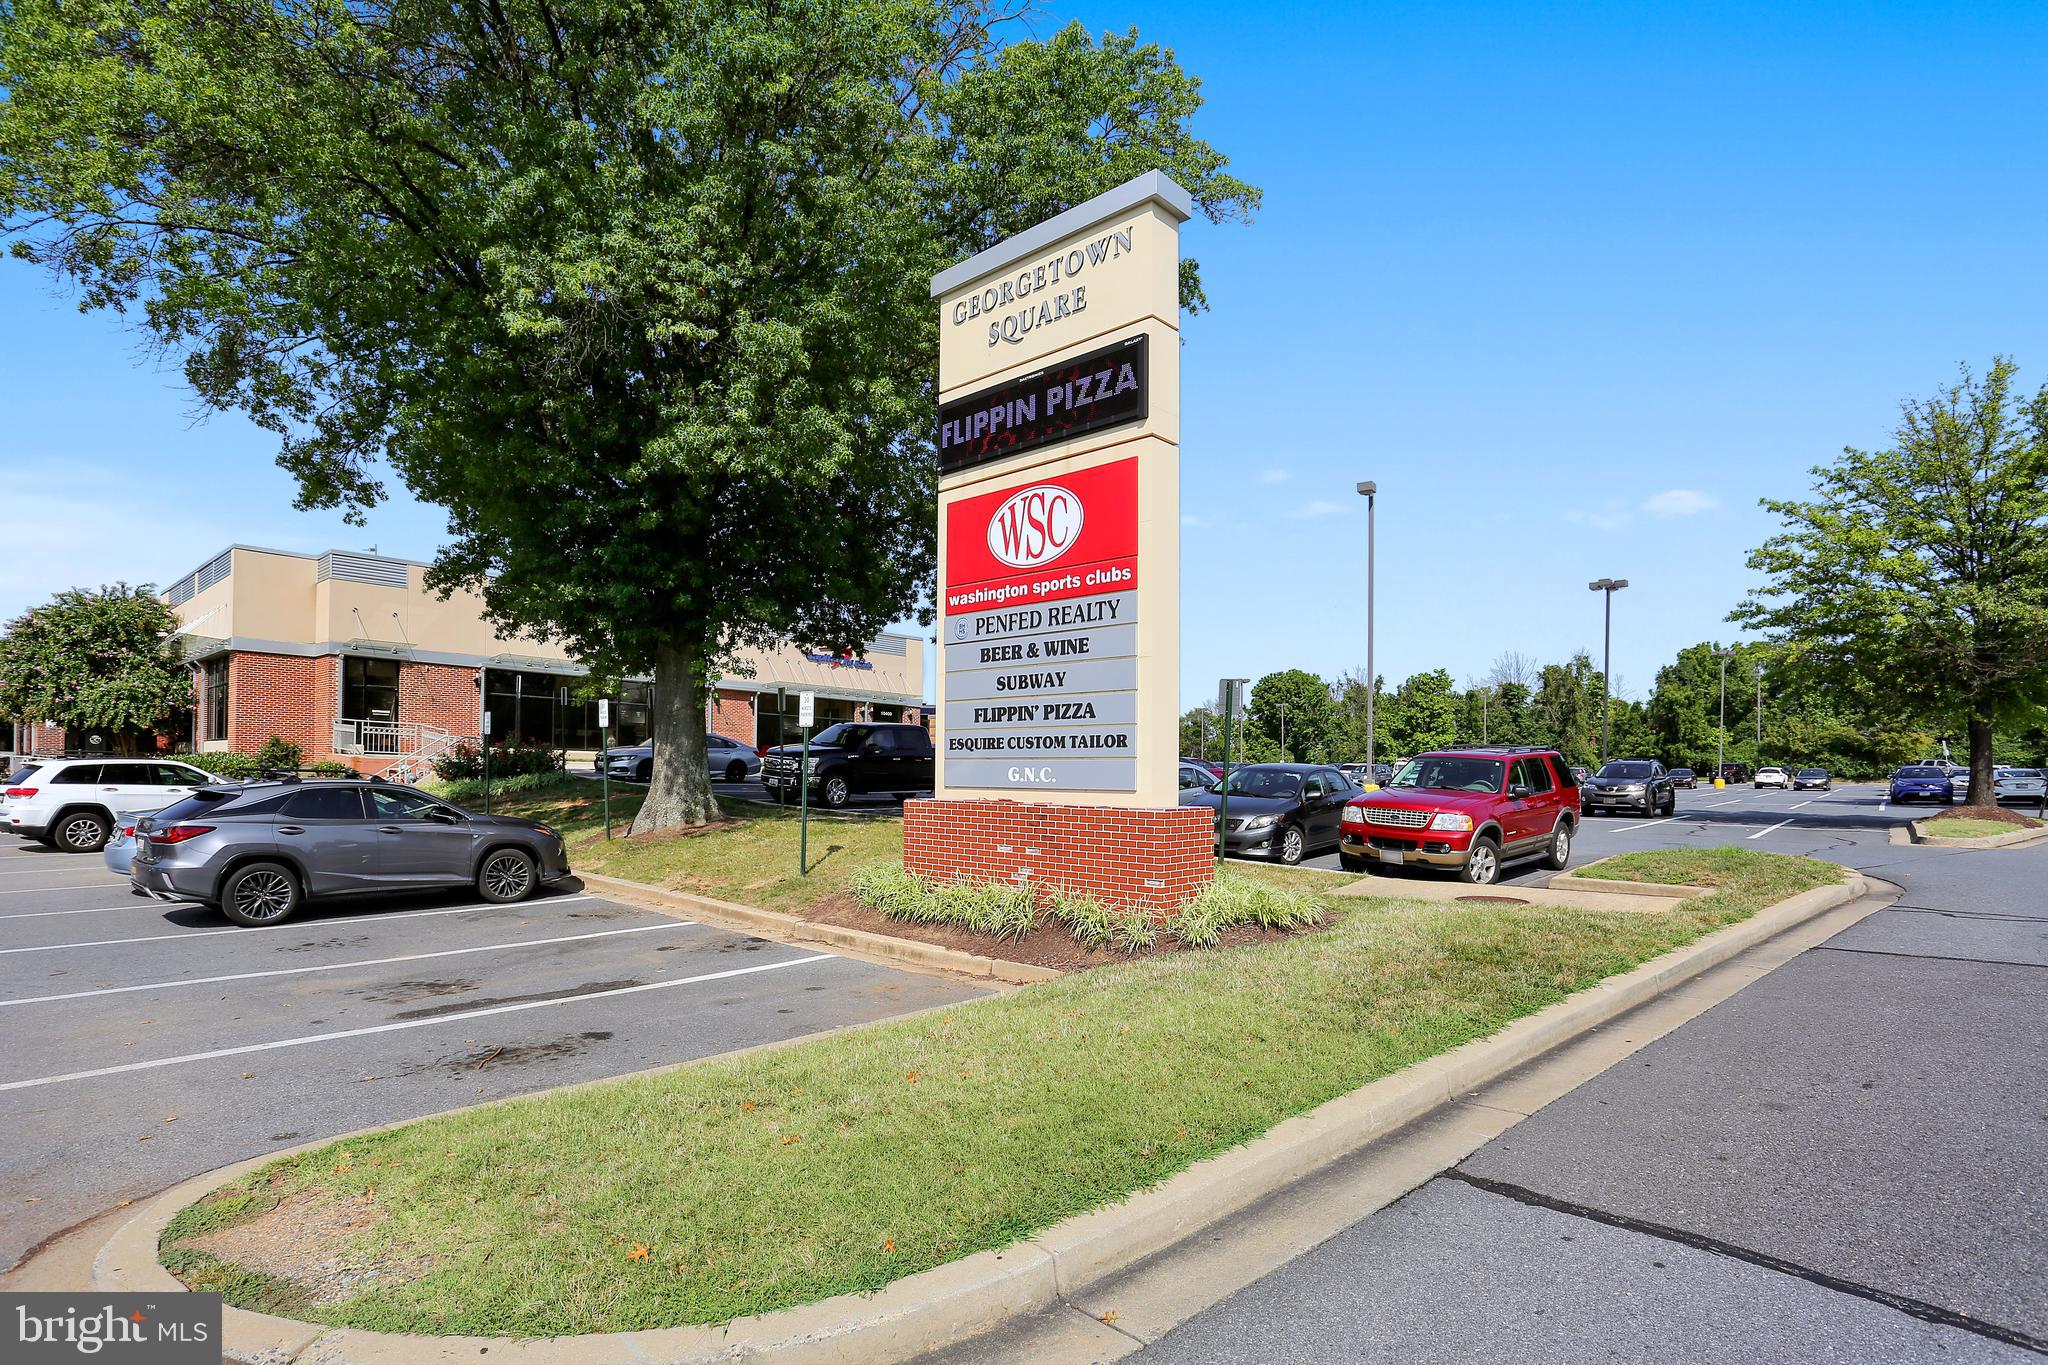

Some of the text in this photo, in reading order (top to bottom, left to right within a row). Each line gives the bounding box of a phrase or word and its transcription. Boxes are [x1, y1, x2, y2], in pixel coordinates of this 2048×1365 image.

[952, 226, 1133, 326] GEORGETOWN
[988, 285, 1087, 348] SQUARE
[942, 362, 1138, 449] FLIPPIN PIZZA
[998, 492, 1068, 560] WSC
[949, 567, 1131, 606] washington sports clubs
[975, 599, 1120, 636] PENFED REALTY
[980, 637, 1089, 663] BEER & WINE
[996, 671, 1066, 691] SUBWAY
[1043, 702, 1096, 721] PIZZA
[949, 734, 1128, 751] ESQUIRE CUSTOM TAILOR
[1008, 766, 1056, 783] G.N.C.
